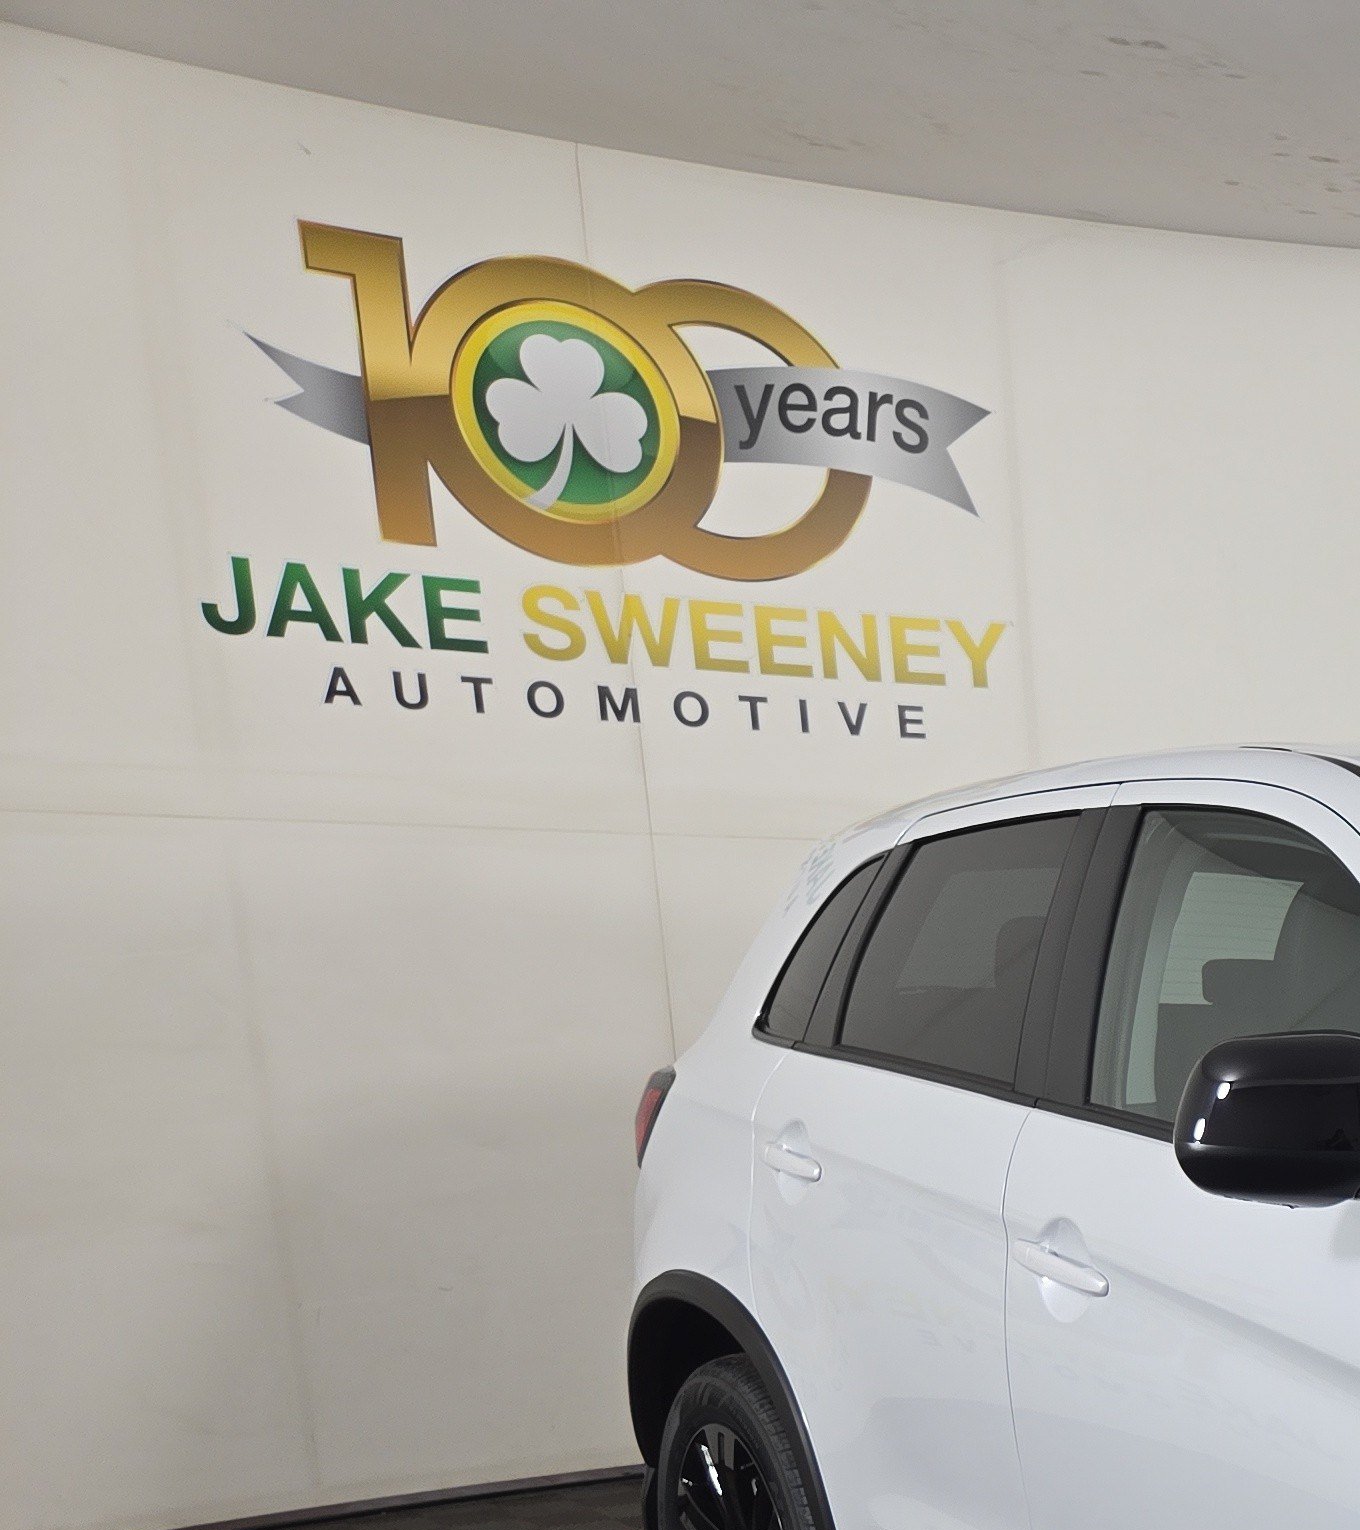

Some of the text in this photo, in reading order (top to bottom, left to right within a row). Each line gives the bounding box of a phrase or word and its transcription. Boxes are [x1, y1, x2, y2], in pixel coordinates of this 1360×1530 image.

[298, 219, 872, 582] 100
[732, 381, 930, 454] years
[201, 555, 1006, 689] JAKE SWEENEY
[323, 666, 927, 739] AUTOMOTIVE
